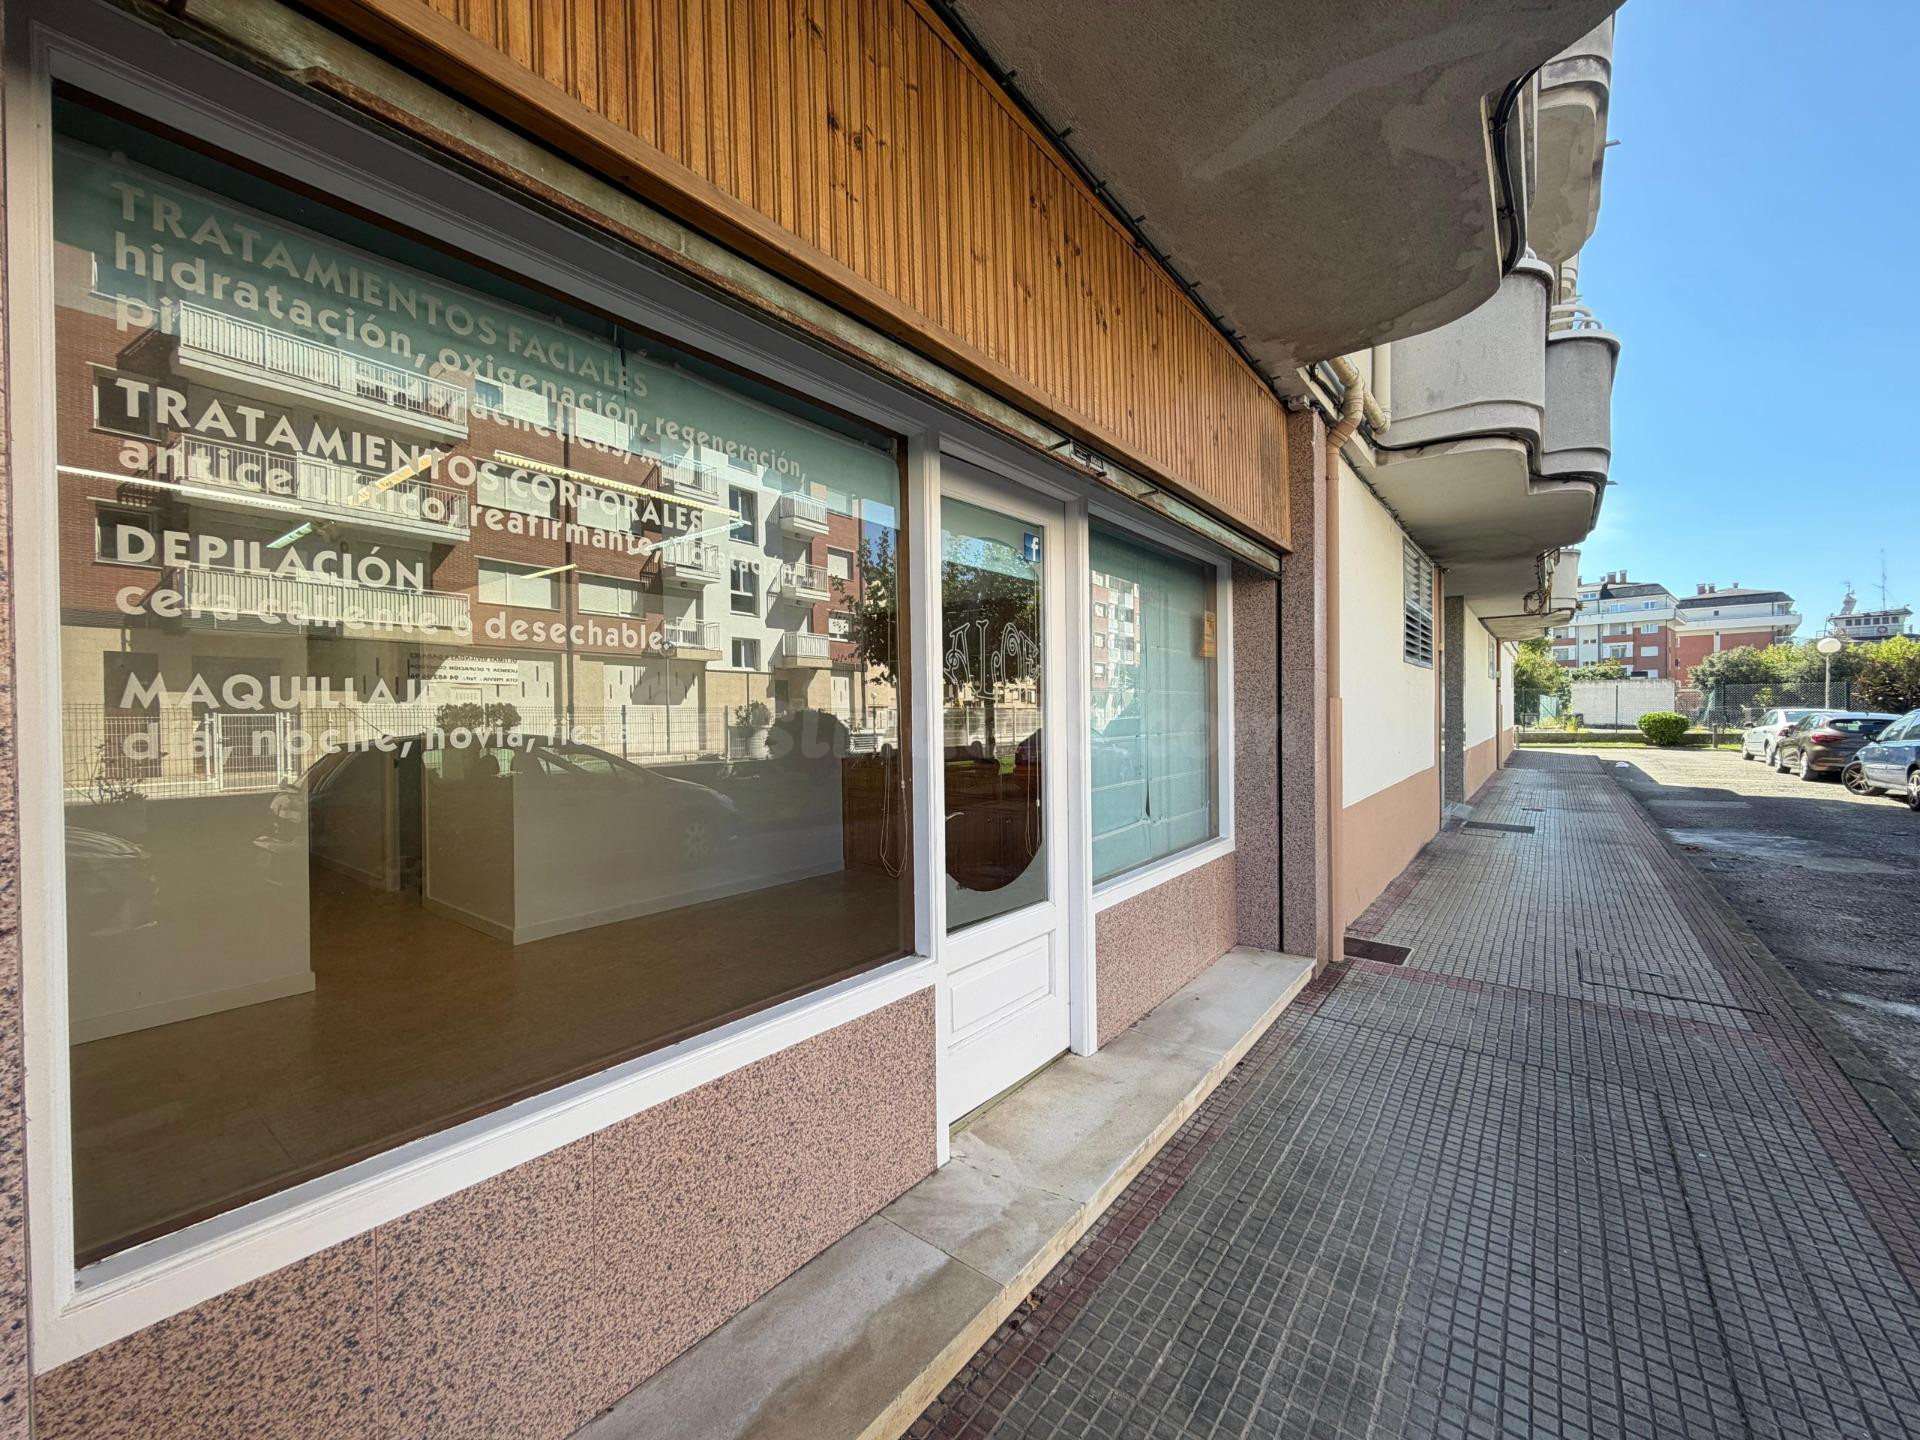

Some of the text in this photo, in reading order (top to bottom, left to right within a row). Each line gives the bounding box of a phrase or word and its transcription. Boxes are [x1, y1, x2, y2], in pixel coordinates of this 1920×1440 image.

[111, 182, 497, 345] TRATAMIENTOS
[508, 328, 649, 397] FACIALES
[115, 232, 427, 369] hidratación,
[438, 347, 648, 436] oxigenación,
[655, 415, 806, 484] regeneración,
[115, 378, 703, 532] TRATAMIENTOS CORPORALES
[116, 524, 424, 592] DEPILACIÓN
[471, 503, 662, 564] reafirmante,
[115, 585, 239, 621] cera
[257, 590, 439, 637] caliente
[120, 671, 438, 711] MAQUILLAJ
[122, 721, 233, 767] da,
[252, 721, 414, 759] noche,
[426, 718, 536, 753] novia,
